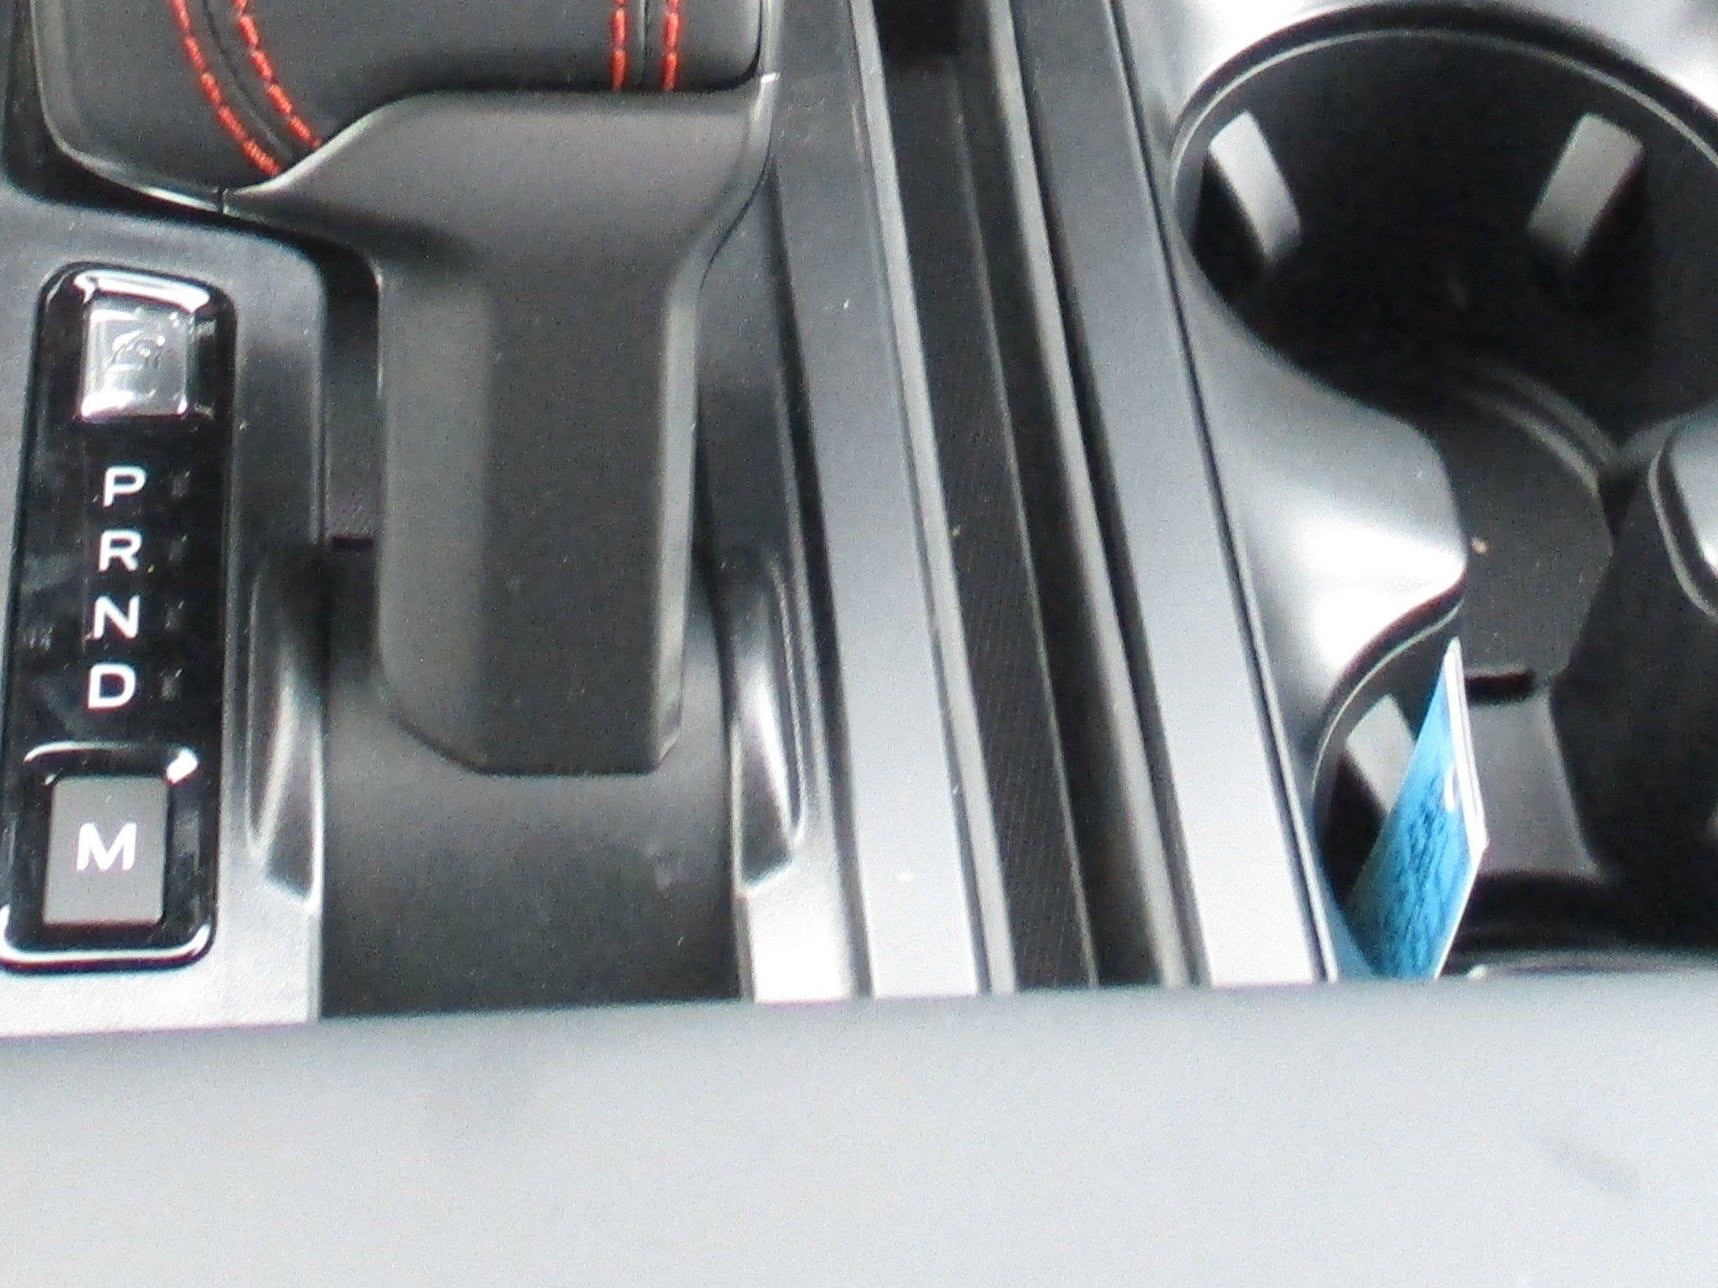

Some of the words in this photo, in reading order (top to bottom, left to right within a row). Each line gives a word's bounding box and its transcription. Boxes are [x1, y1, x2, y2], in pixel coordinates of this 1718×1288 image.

[103, 466, 146, 507] P
[97, 531, 141, 573] R
[92, 596, 139, 639] N
[86, 663, 137, 711] D
[75, 821, 138, 872] M
